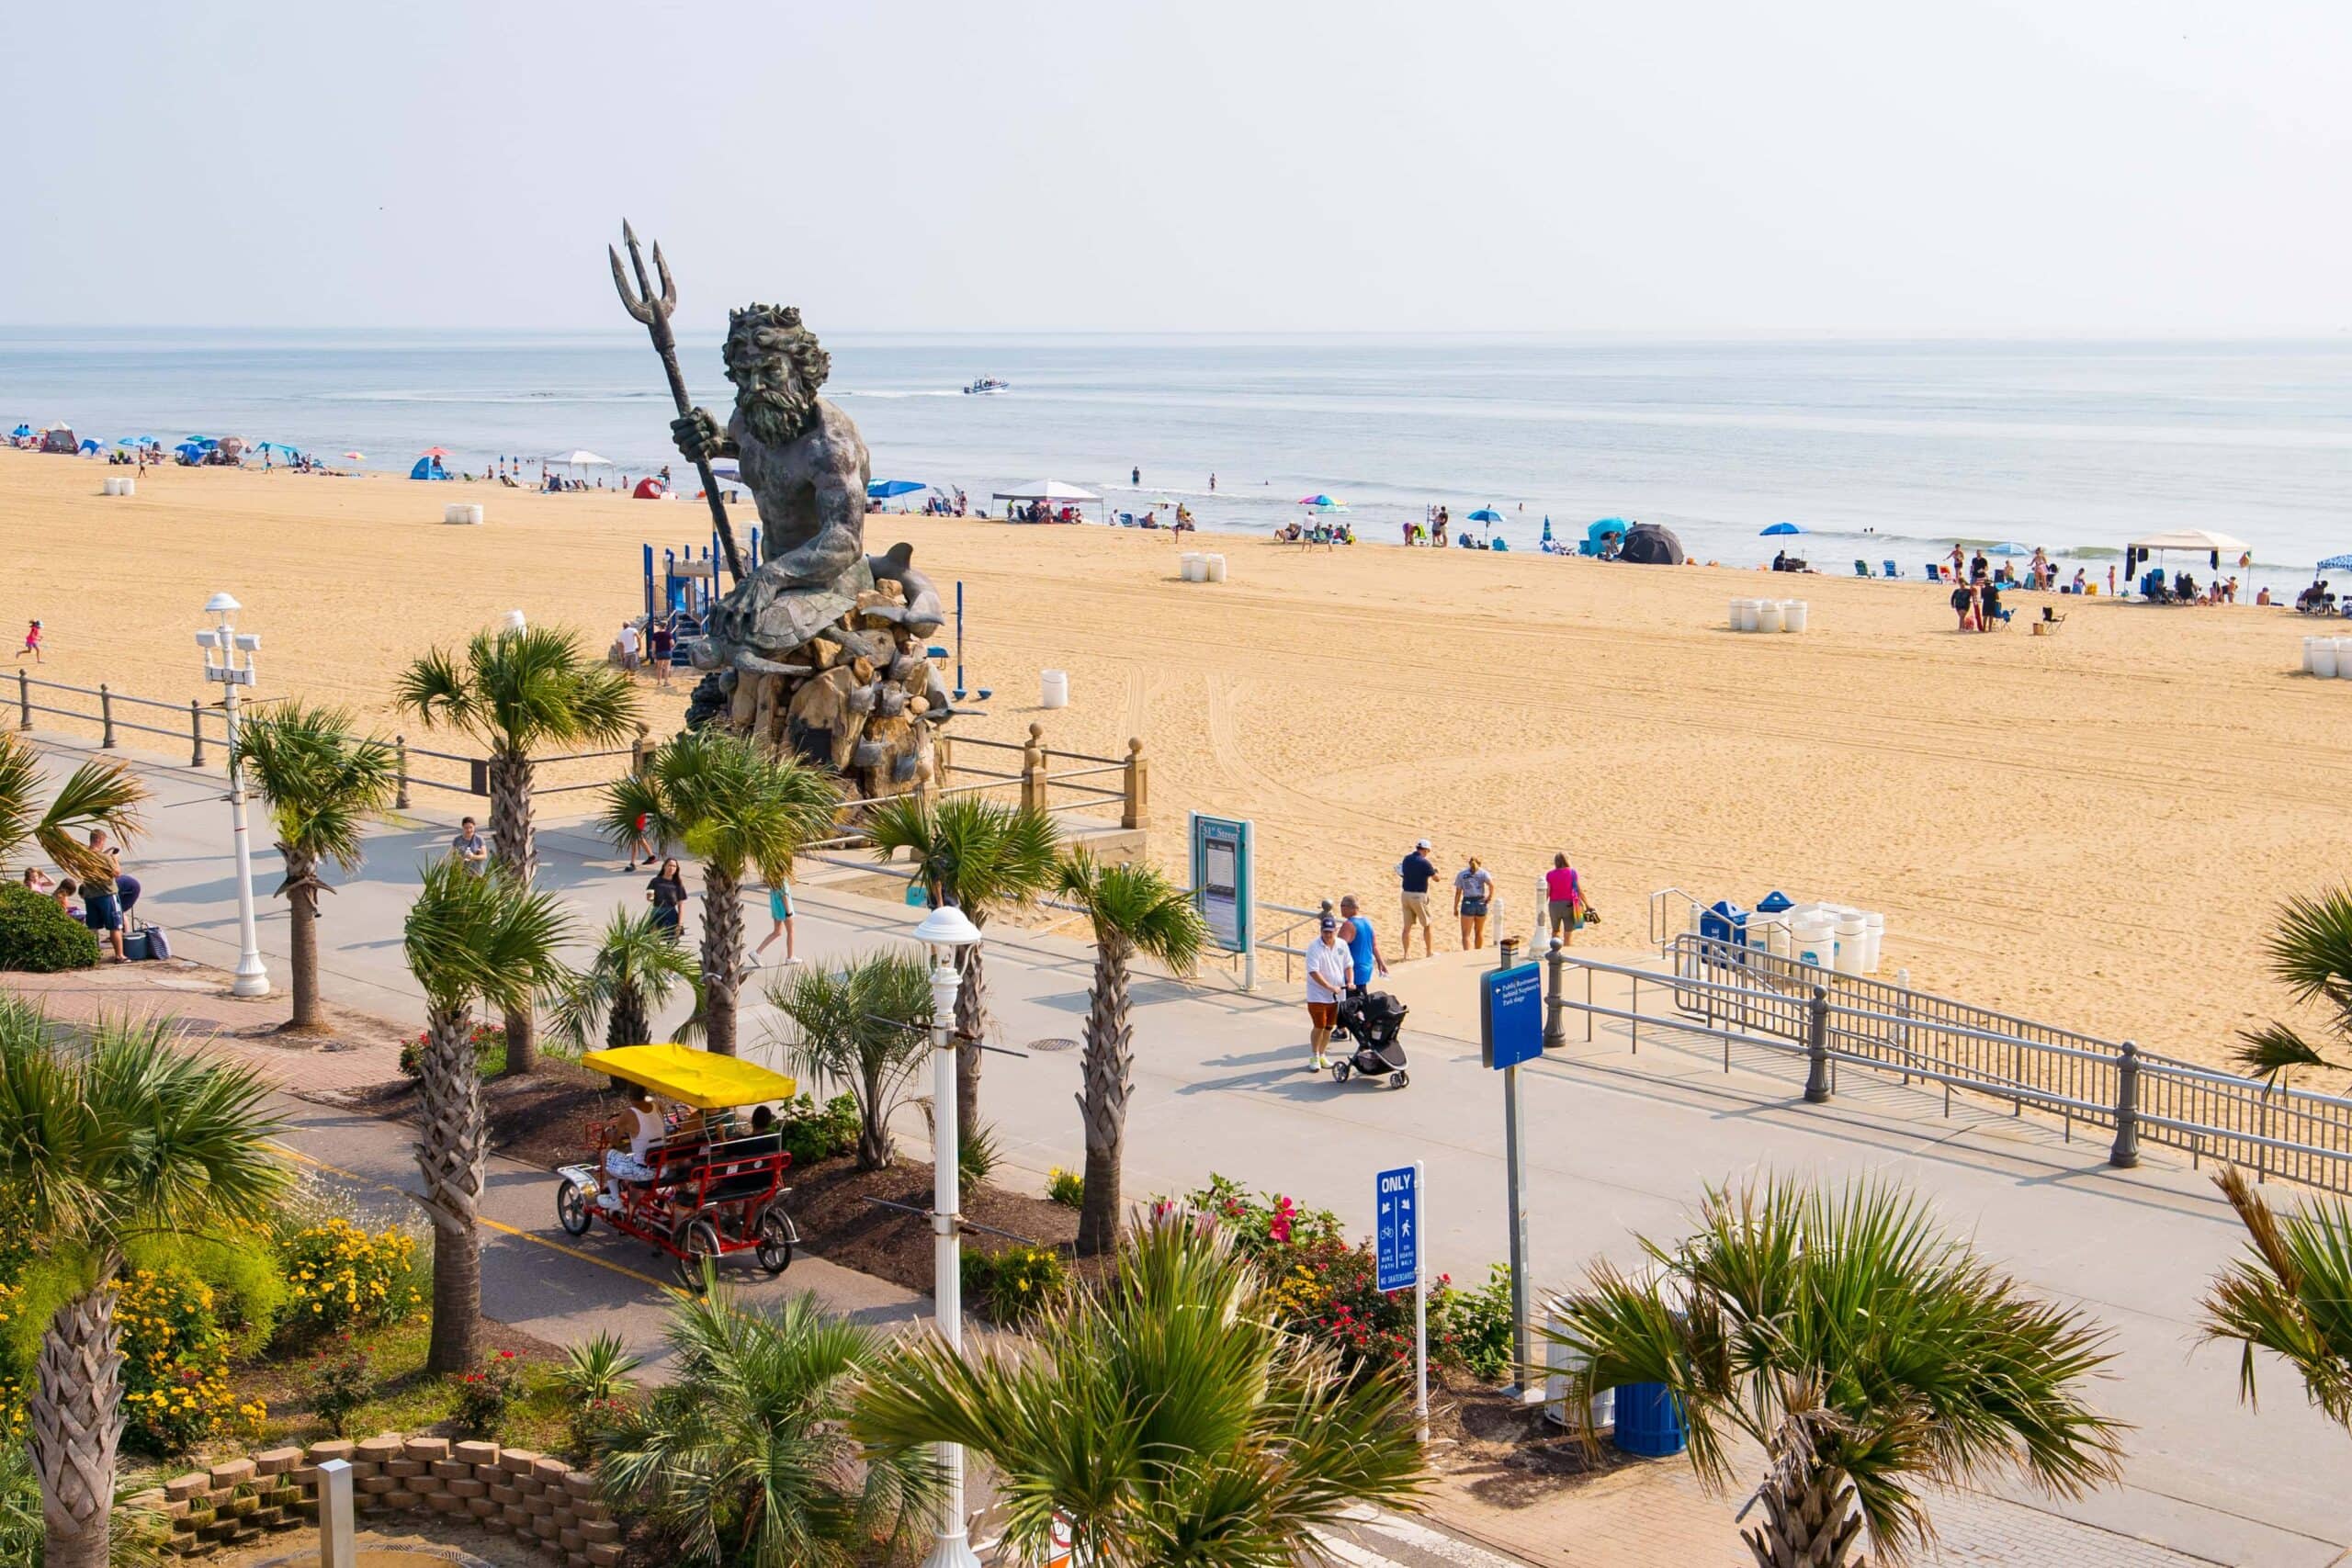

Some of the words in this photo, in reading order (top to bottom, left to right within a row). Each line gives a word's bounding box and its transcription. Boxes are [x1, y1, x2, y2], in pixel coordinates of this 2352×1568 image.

[1217, 829, 1238, 839] Street
[1381, 1174, 1411, 1193] ONLY
[1399, 1251, 1414, 1259] BOARD
